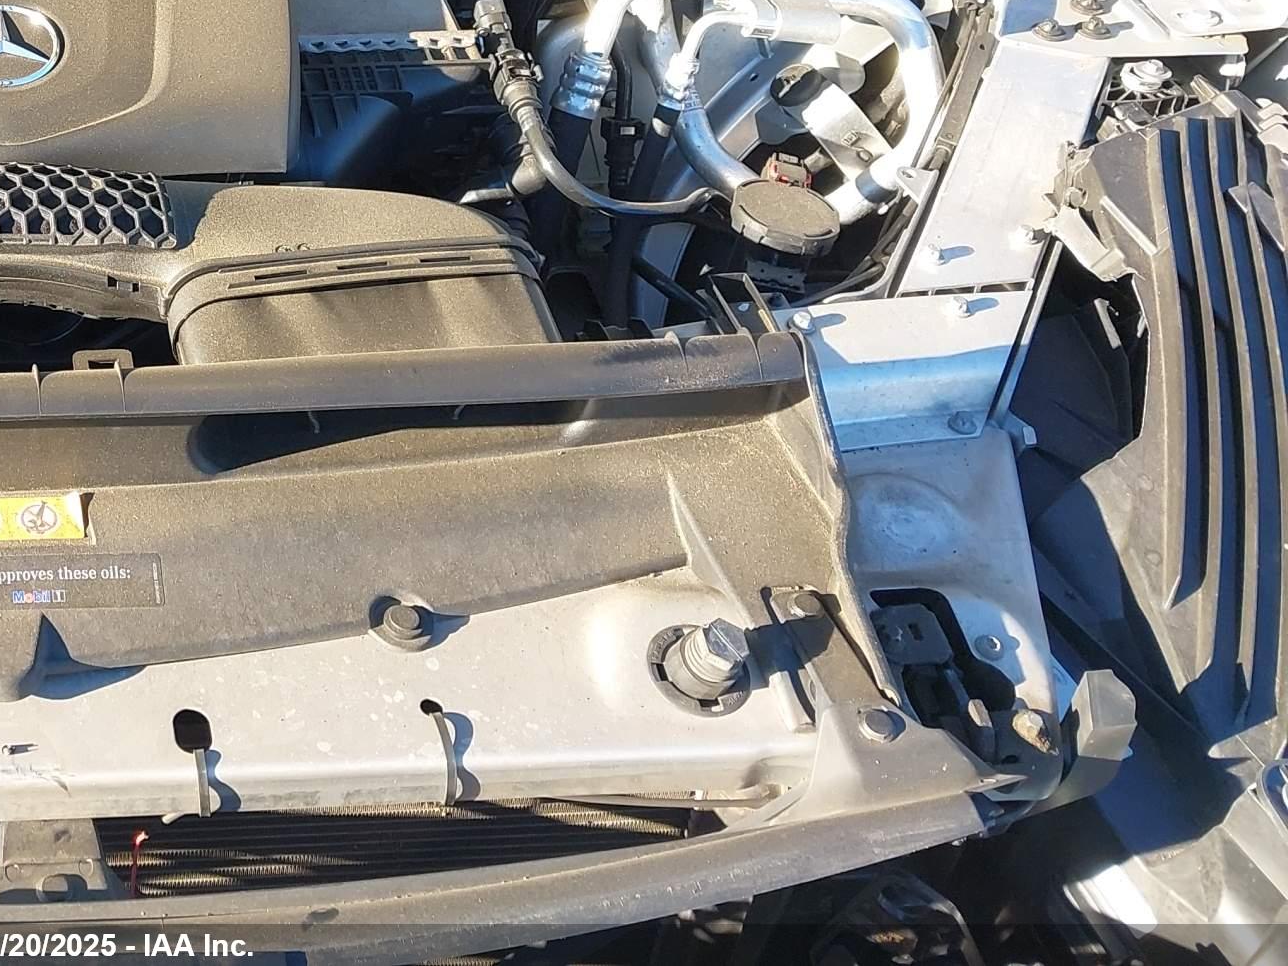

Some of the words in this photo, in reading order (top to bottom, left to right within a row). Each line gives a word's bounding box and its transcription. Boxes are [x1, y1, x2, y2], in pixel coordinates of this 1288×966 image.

[57, 566, 97, 581] these
[100, 565, 132, 580] oils:
[12, 590, 51, 604] Mobil
